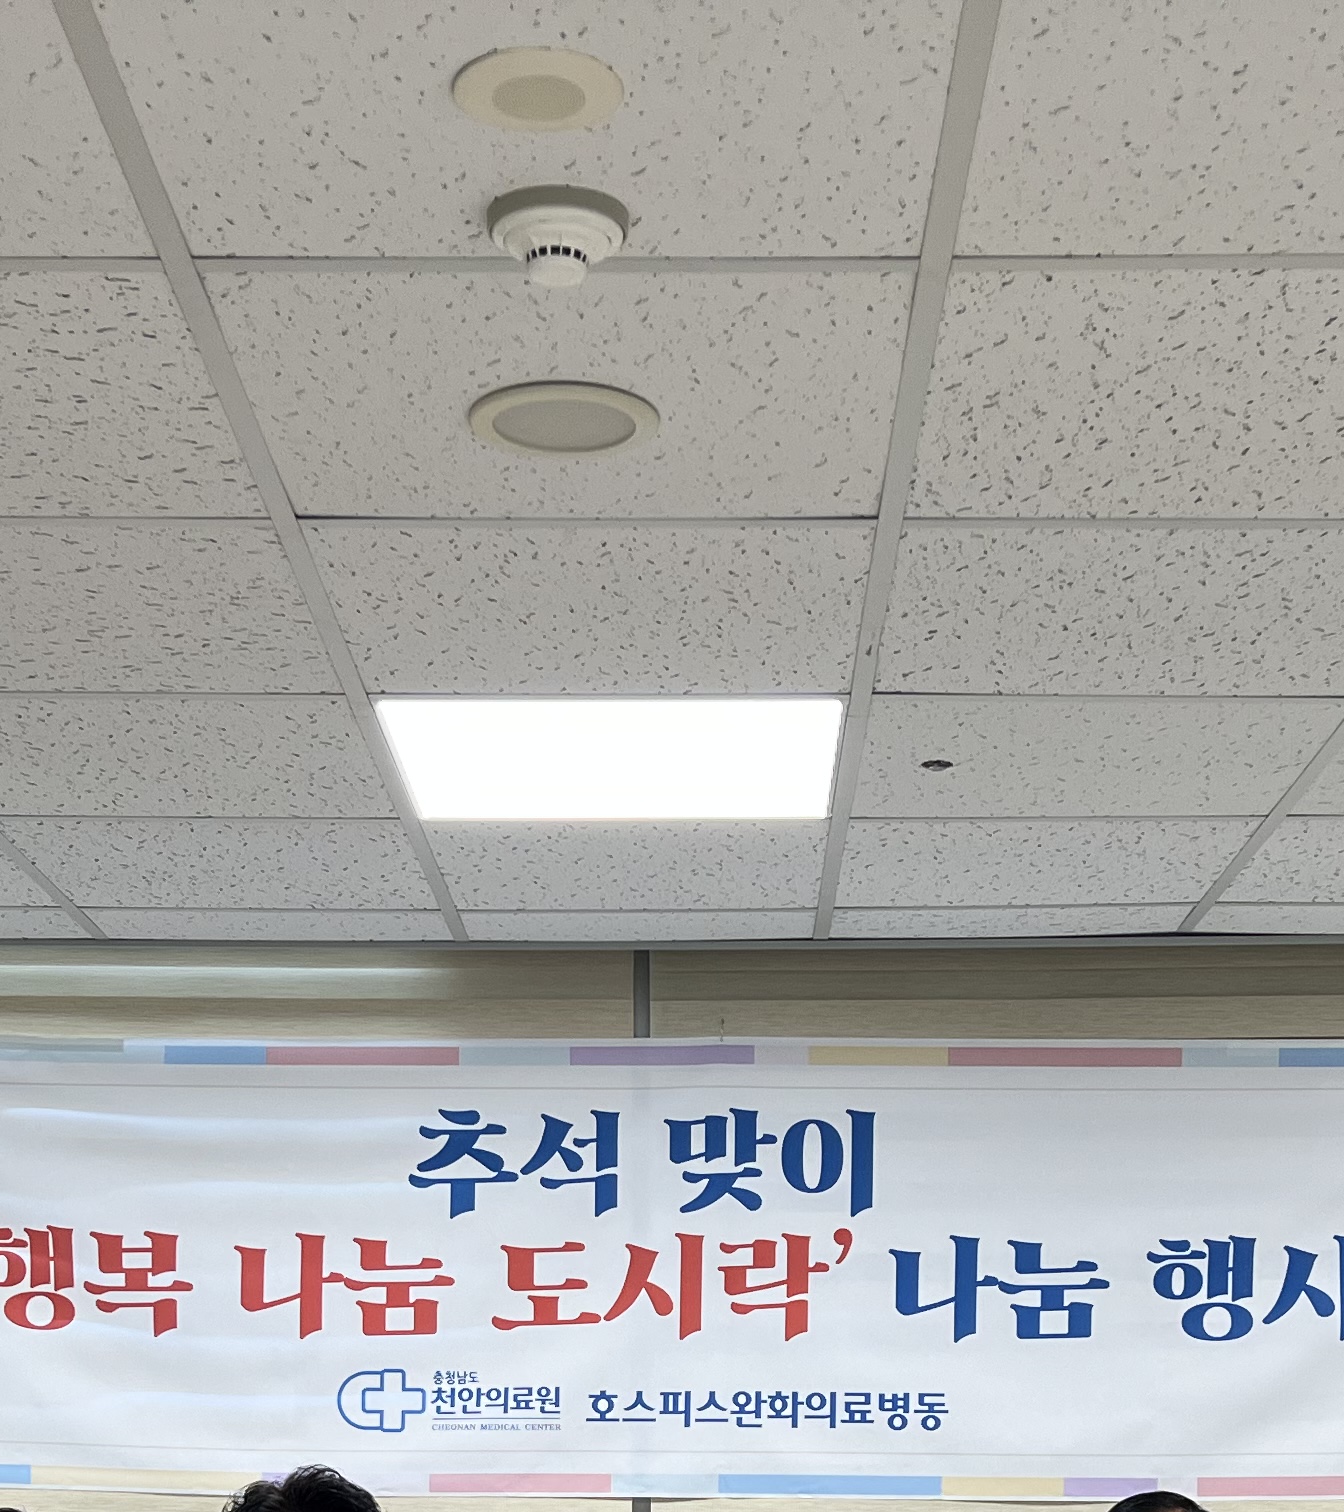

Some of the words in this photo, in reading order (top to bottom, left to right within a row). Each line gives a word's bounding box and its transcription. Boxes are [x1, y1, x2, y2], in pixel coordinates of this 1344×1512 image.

[408, 1107, 621, 1220] 추석
[663, 1106, 877, 1218] 맞이
[233, 1231, 456, 1340] 나눔
[888, 1233, 1111, 1344] 나눔
[432, 1370, 480, 1386] 충청남도
[430, 1386, 562, 1415] 천안의료원
[585, 1388, 950, 1433] 호스피스완화의료병동
[431, 1423, 476, 1431] CHEONAN
[480, 1423, 522, 1431] MEDICAL
[524, 1423, 562, 1431] CENTER
